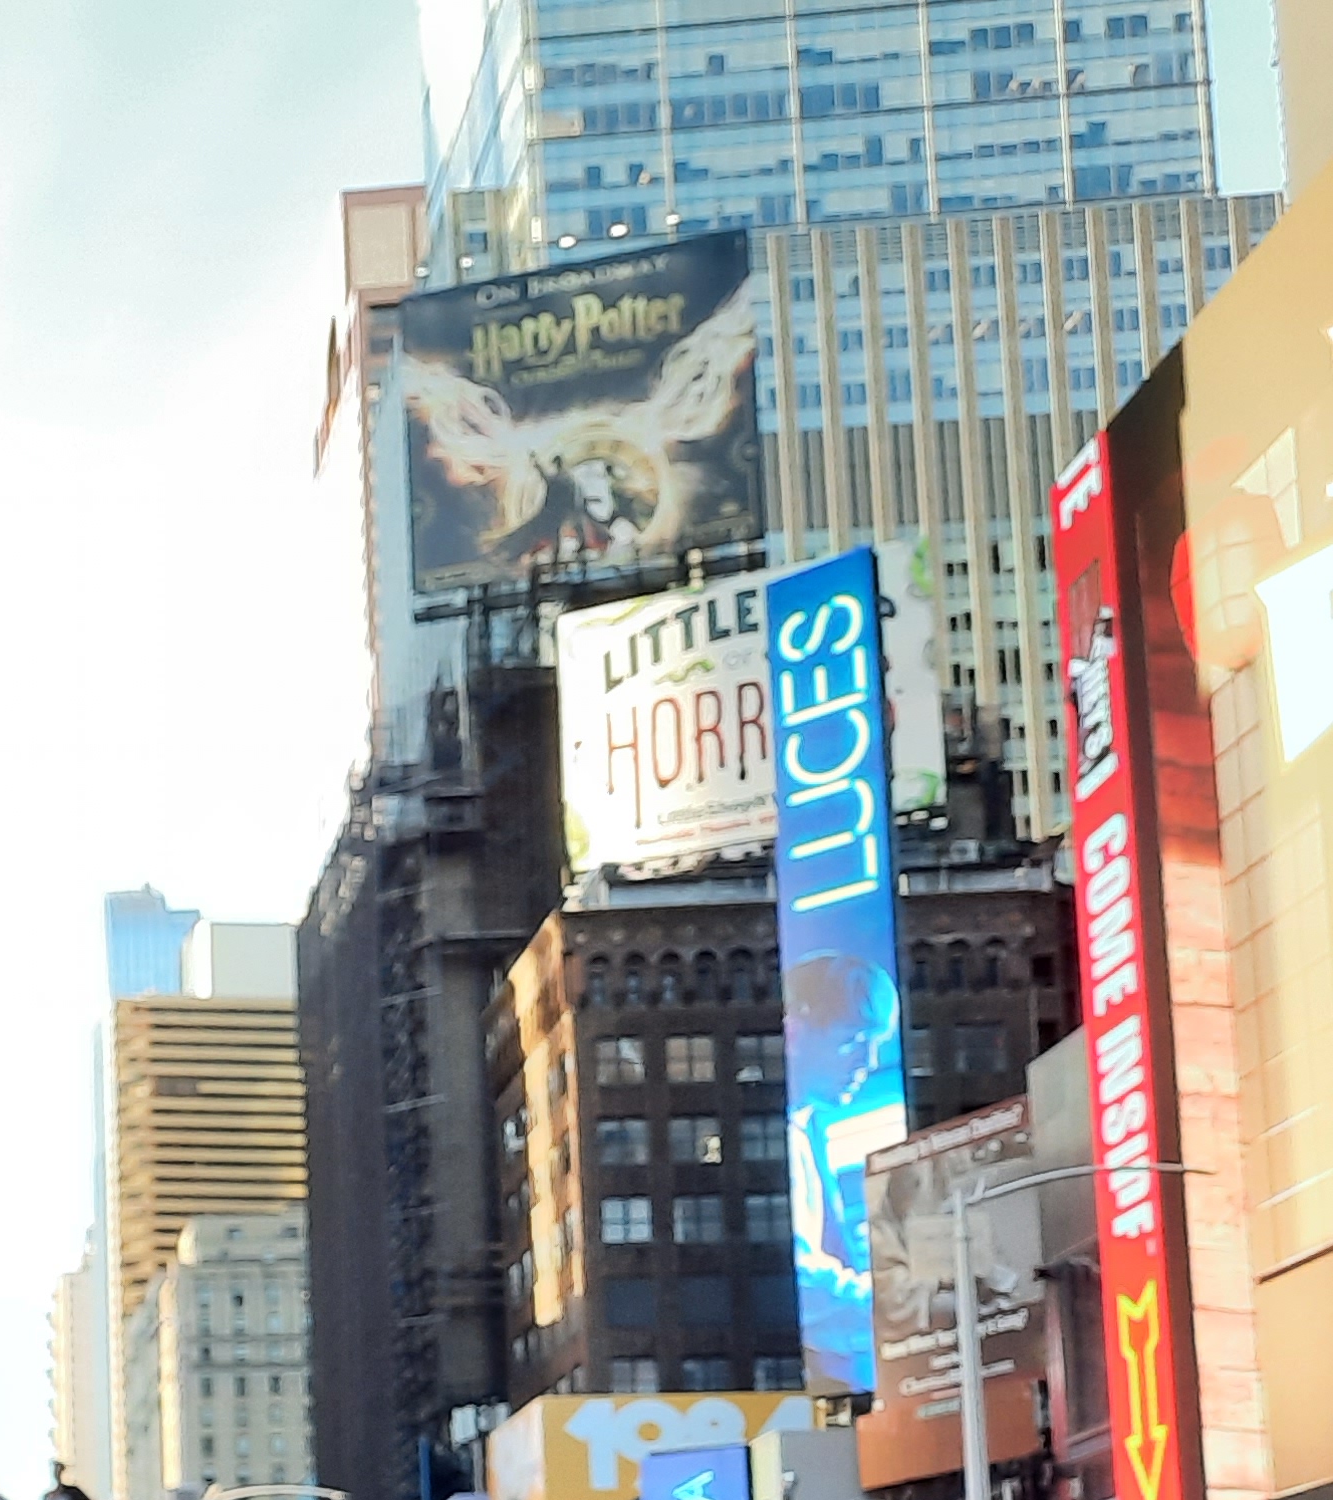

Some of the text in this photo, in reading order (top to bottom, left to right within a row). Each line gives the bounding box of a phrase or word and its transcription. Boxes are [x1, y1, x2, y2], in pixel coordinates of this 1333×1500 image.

[468, 310, 574, 382] Harry
[571, 292, 685, 361] Potter
[603, 589, 759, 694] LITTLE
[777, 594, 879, 912] LUCES
[1082, 812, 1139, 1018] COME
